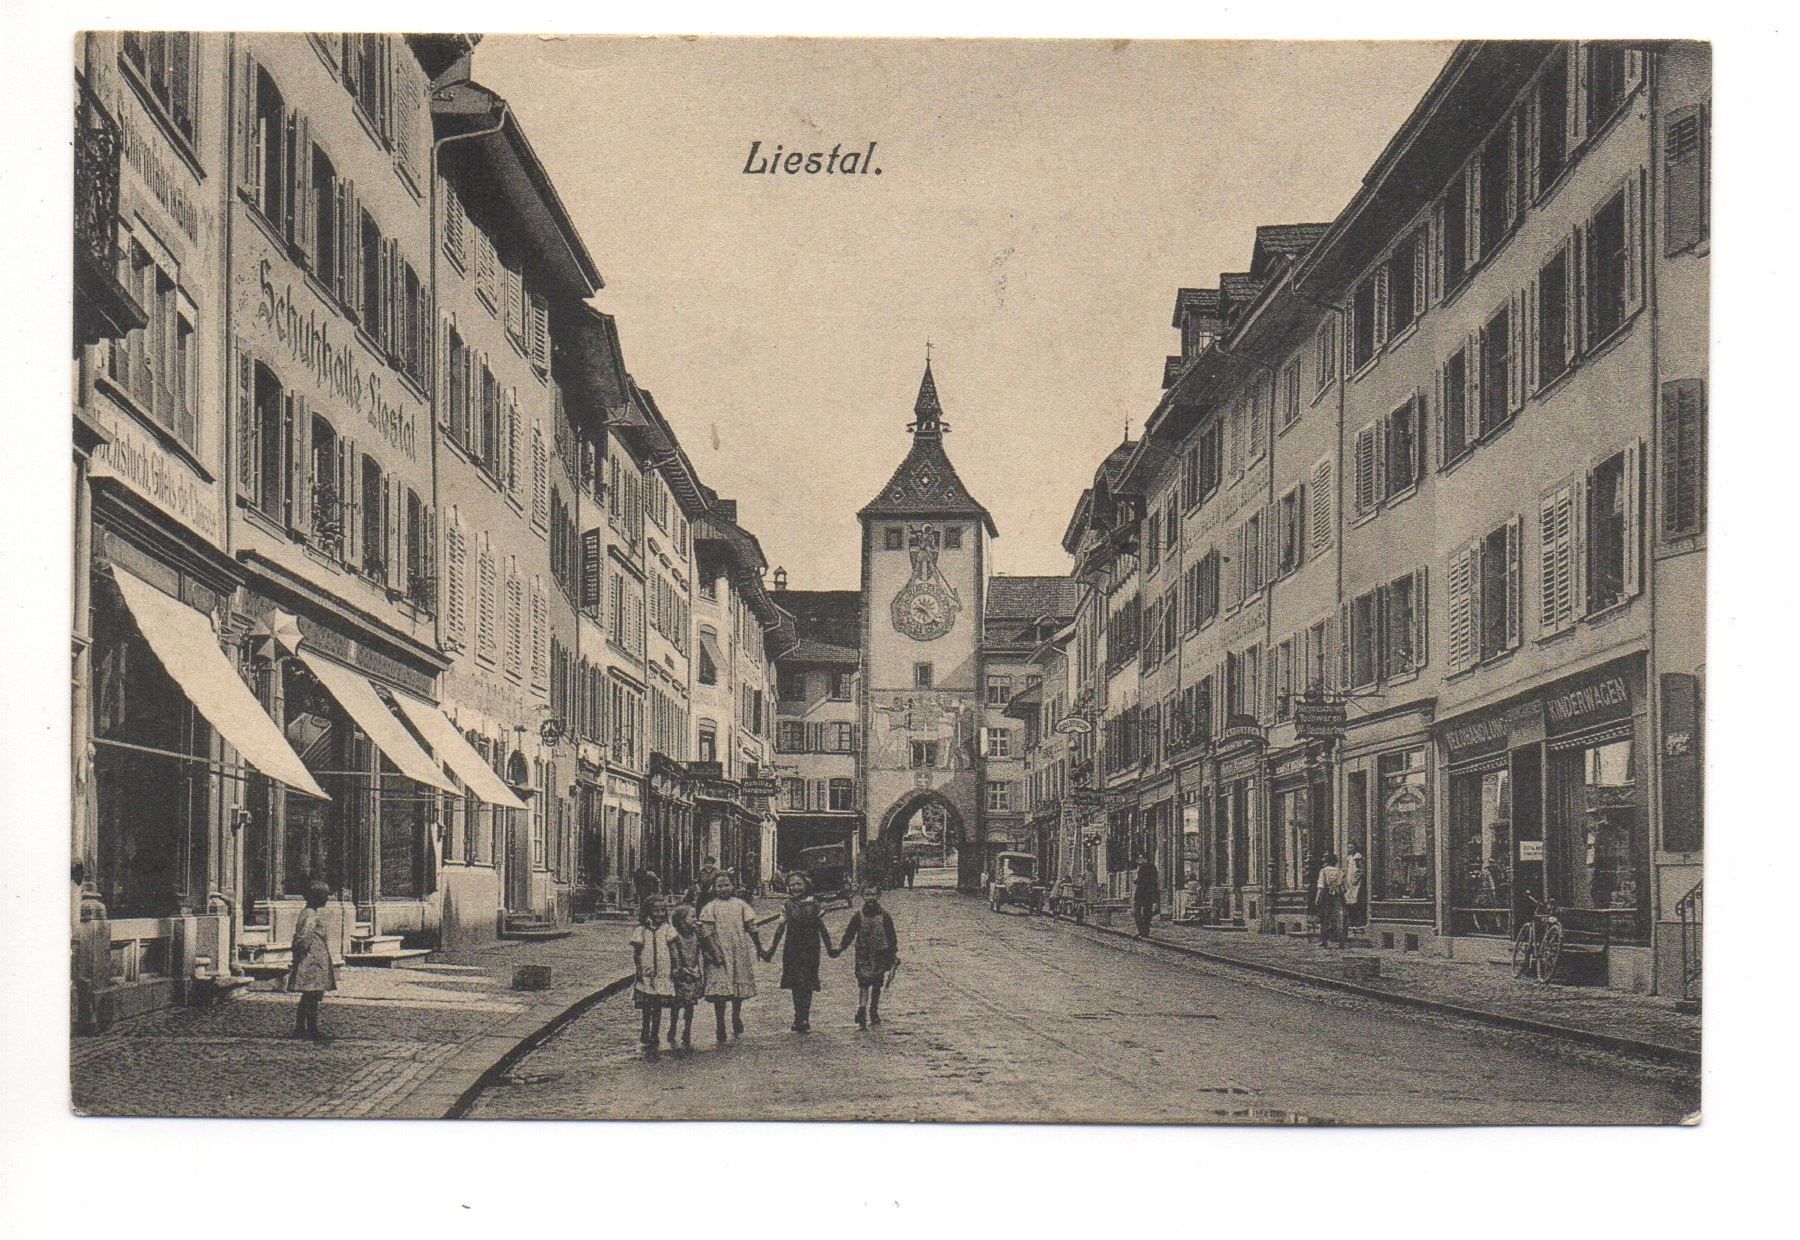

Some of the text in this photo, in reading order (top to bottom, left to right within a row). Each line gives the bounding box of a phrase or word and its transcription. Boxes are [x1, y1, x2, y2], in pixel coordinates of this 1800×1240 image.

[257, 258, 417, 463] Schuhhalle Liestal
[1547, 677, 1628, 721] KINDERWAGEN
